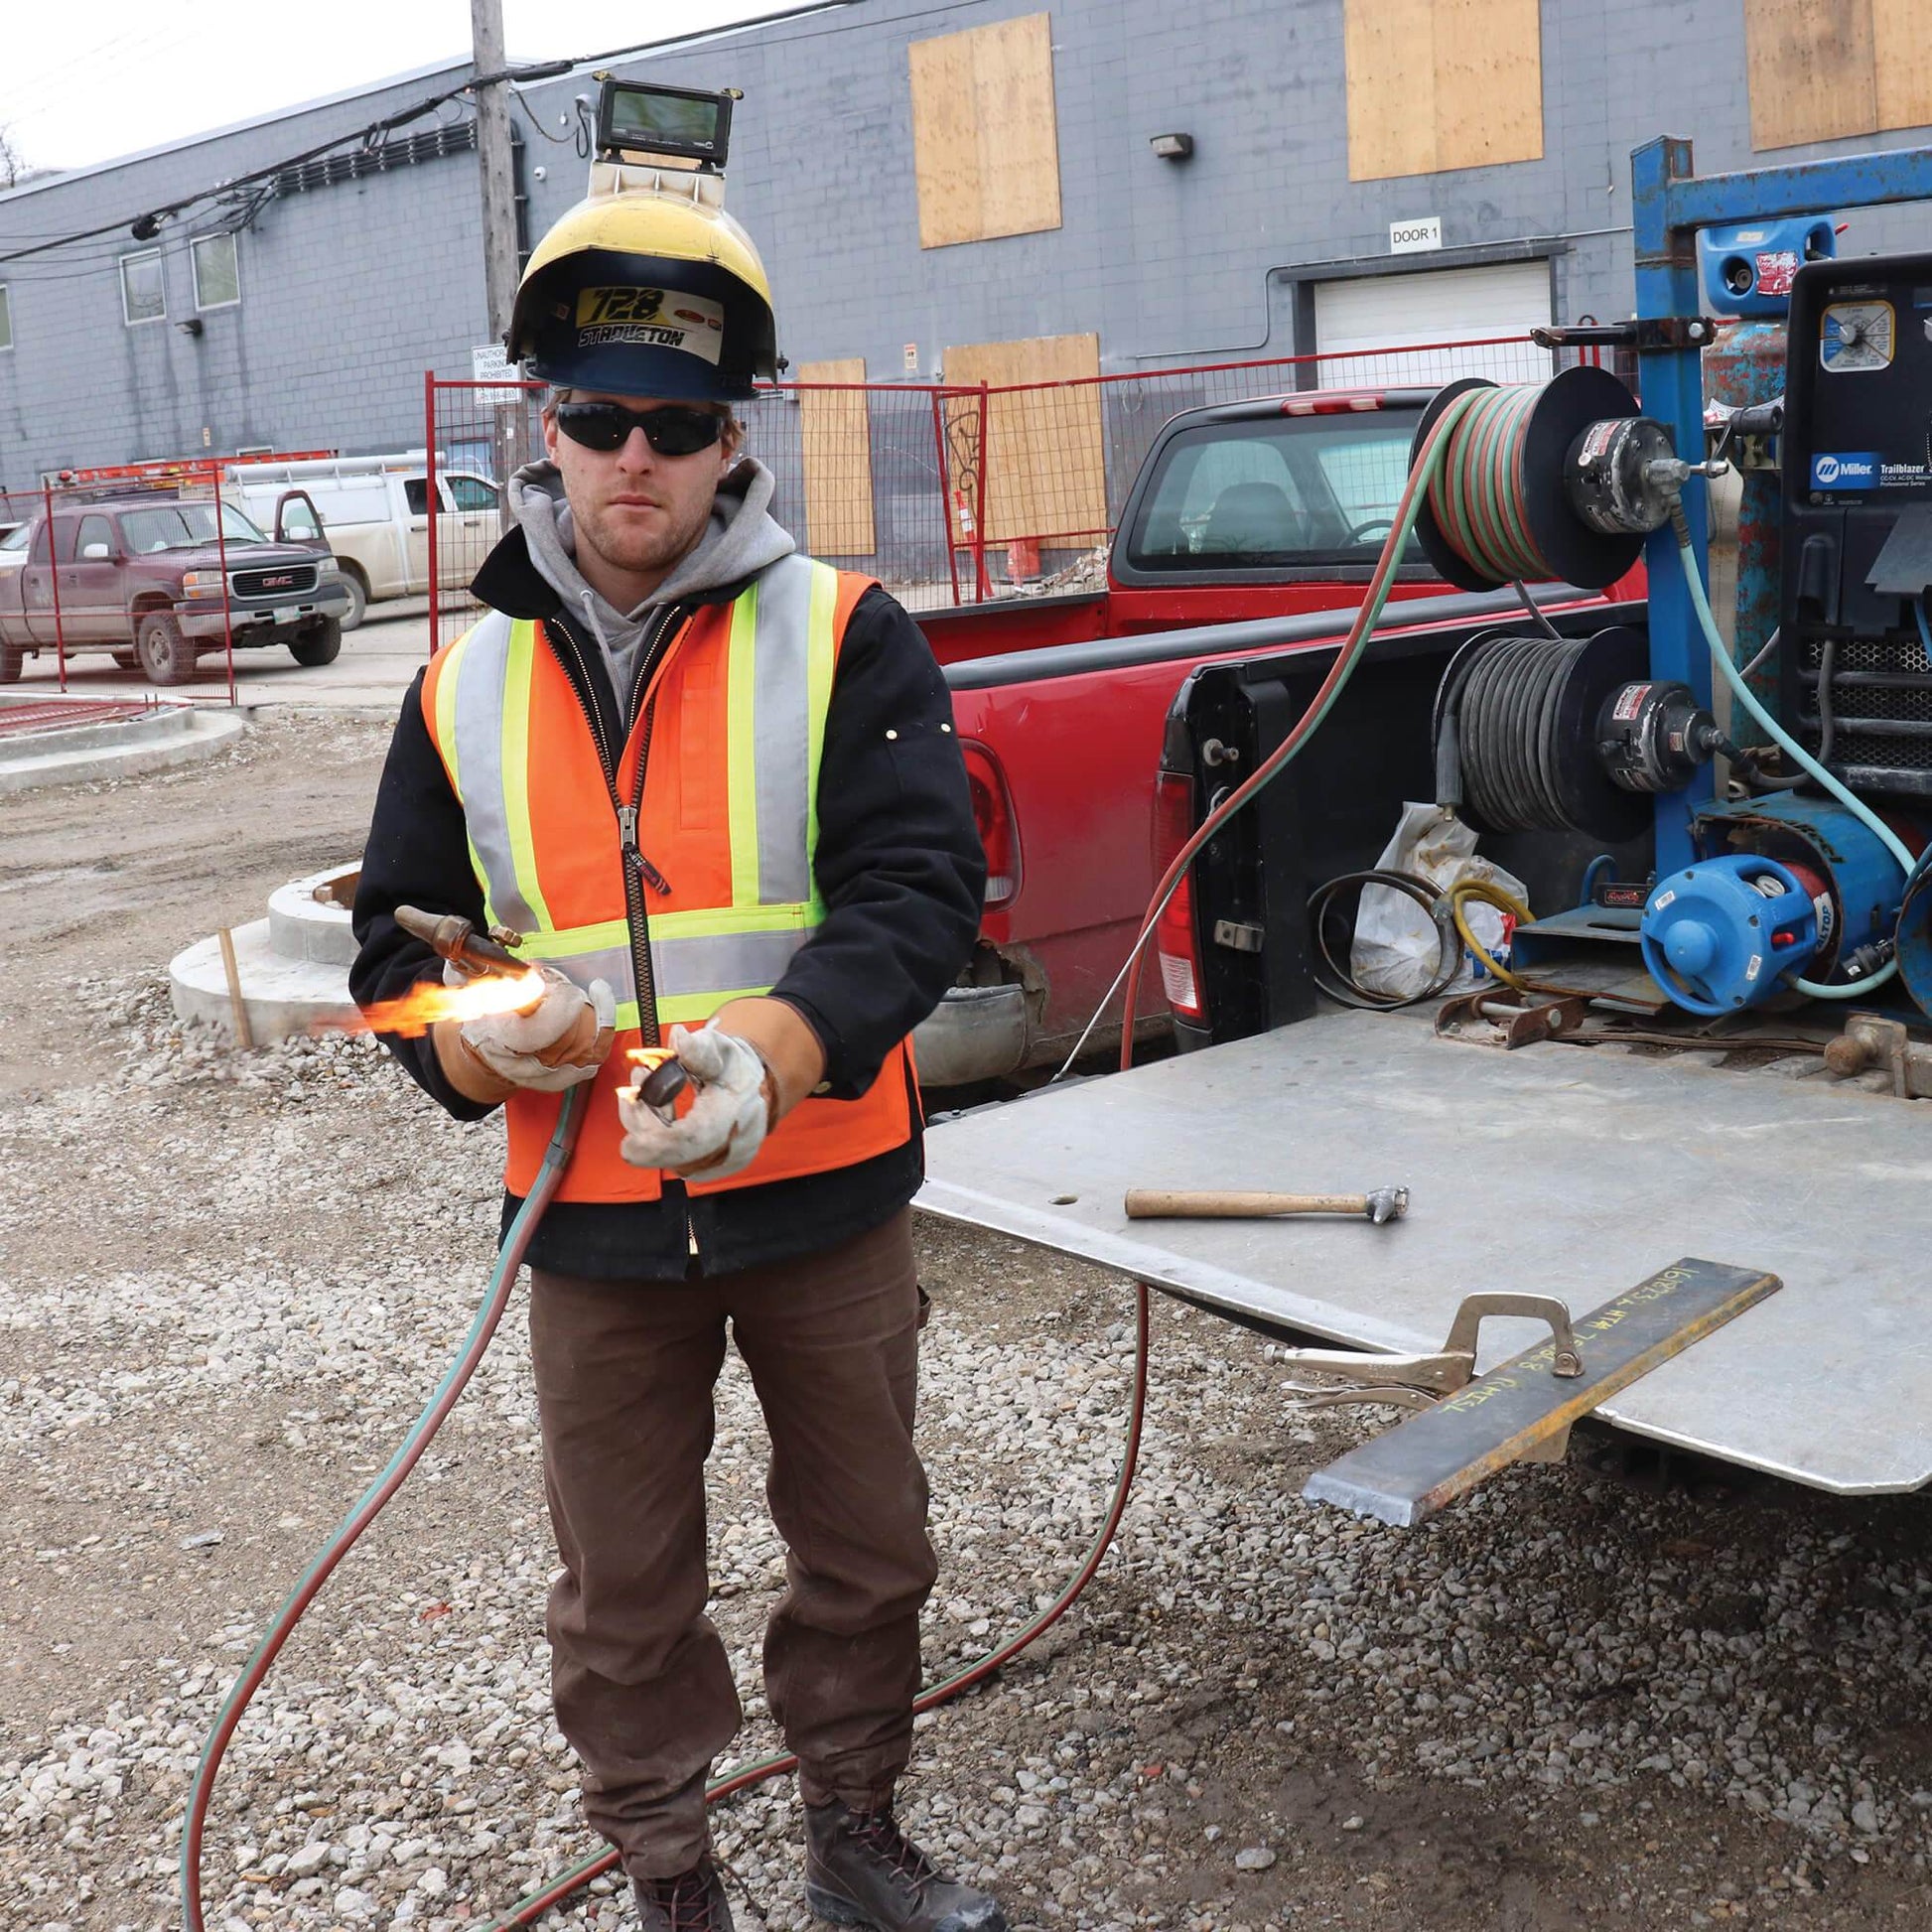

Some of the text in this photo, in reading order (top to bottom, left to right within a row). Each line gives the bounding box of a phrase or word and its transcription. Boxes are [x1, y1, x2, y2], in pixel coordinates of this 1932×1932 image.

[1393, 226, 1438, 243] DOOR 1
[475, 348, 506, 361] UNAUTHOR
[483, 359, 506, 370] PARKIN
[1880, 464, 1925, 475] Trailblazer
[262, 576, 294, 588] GMC
